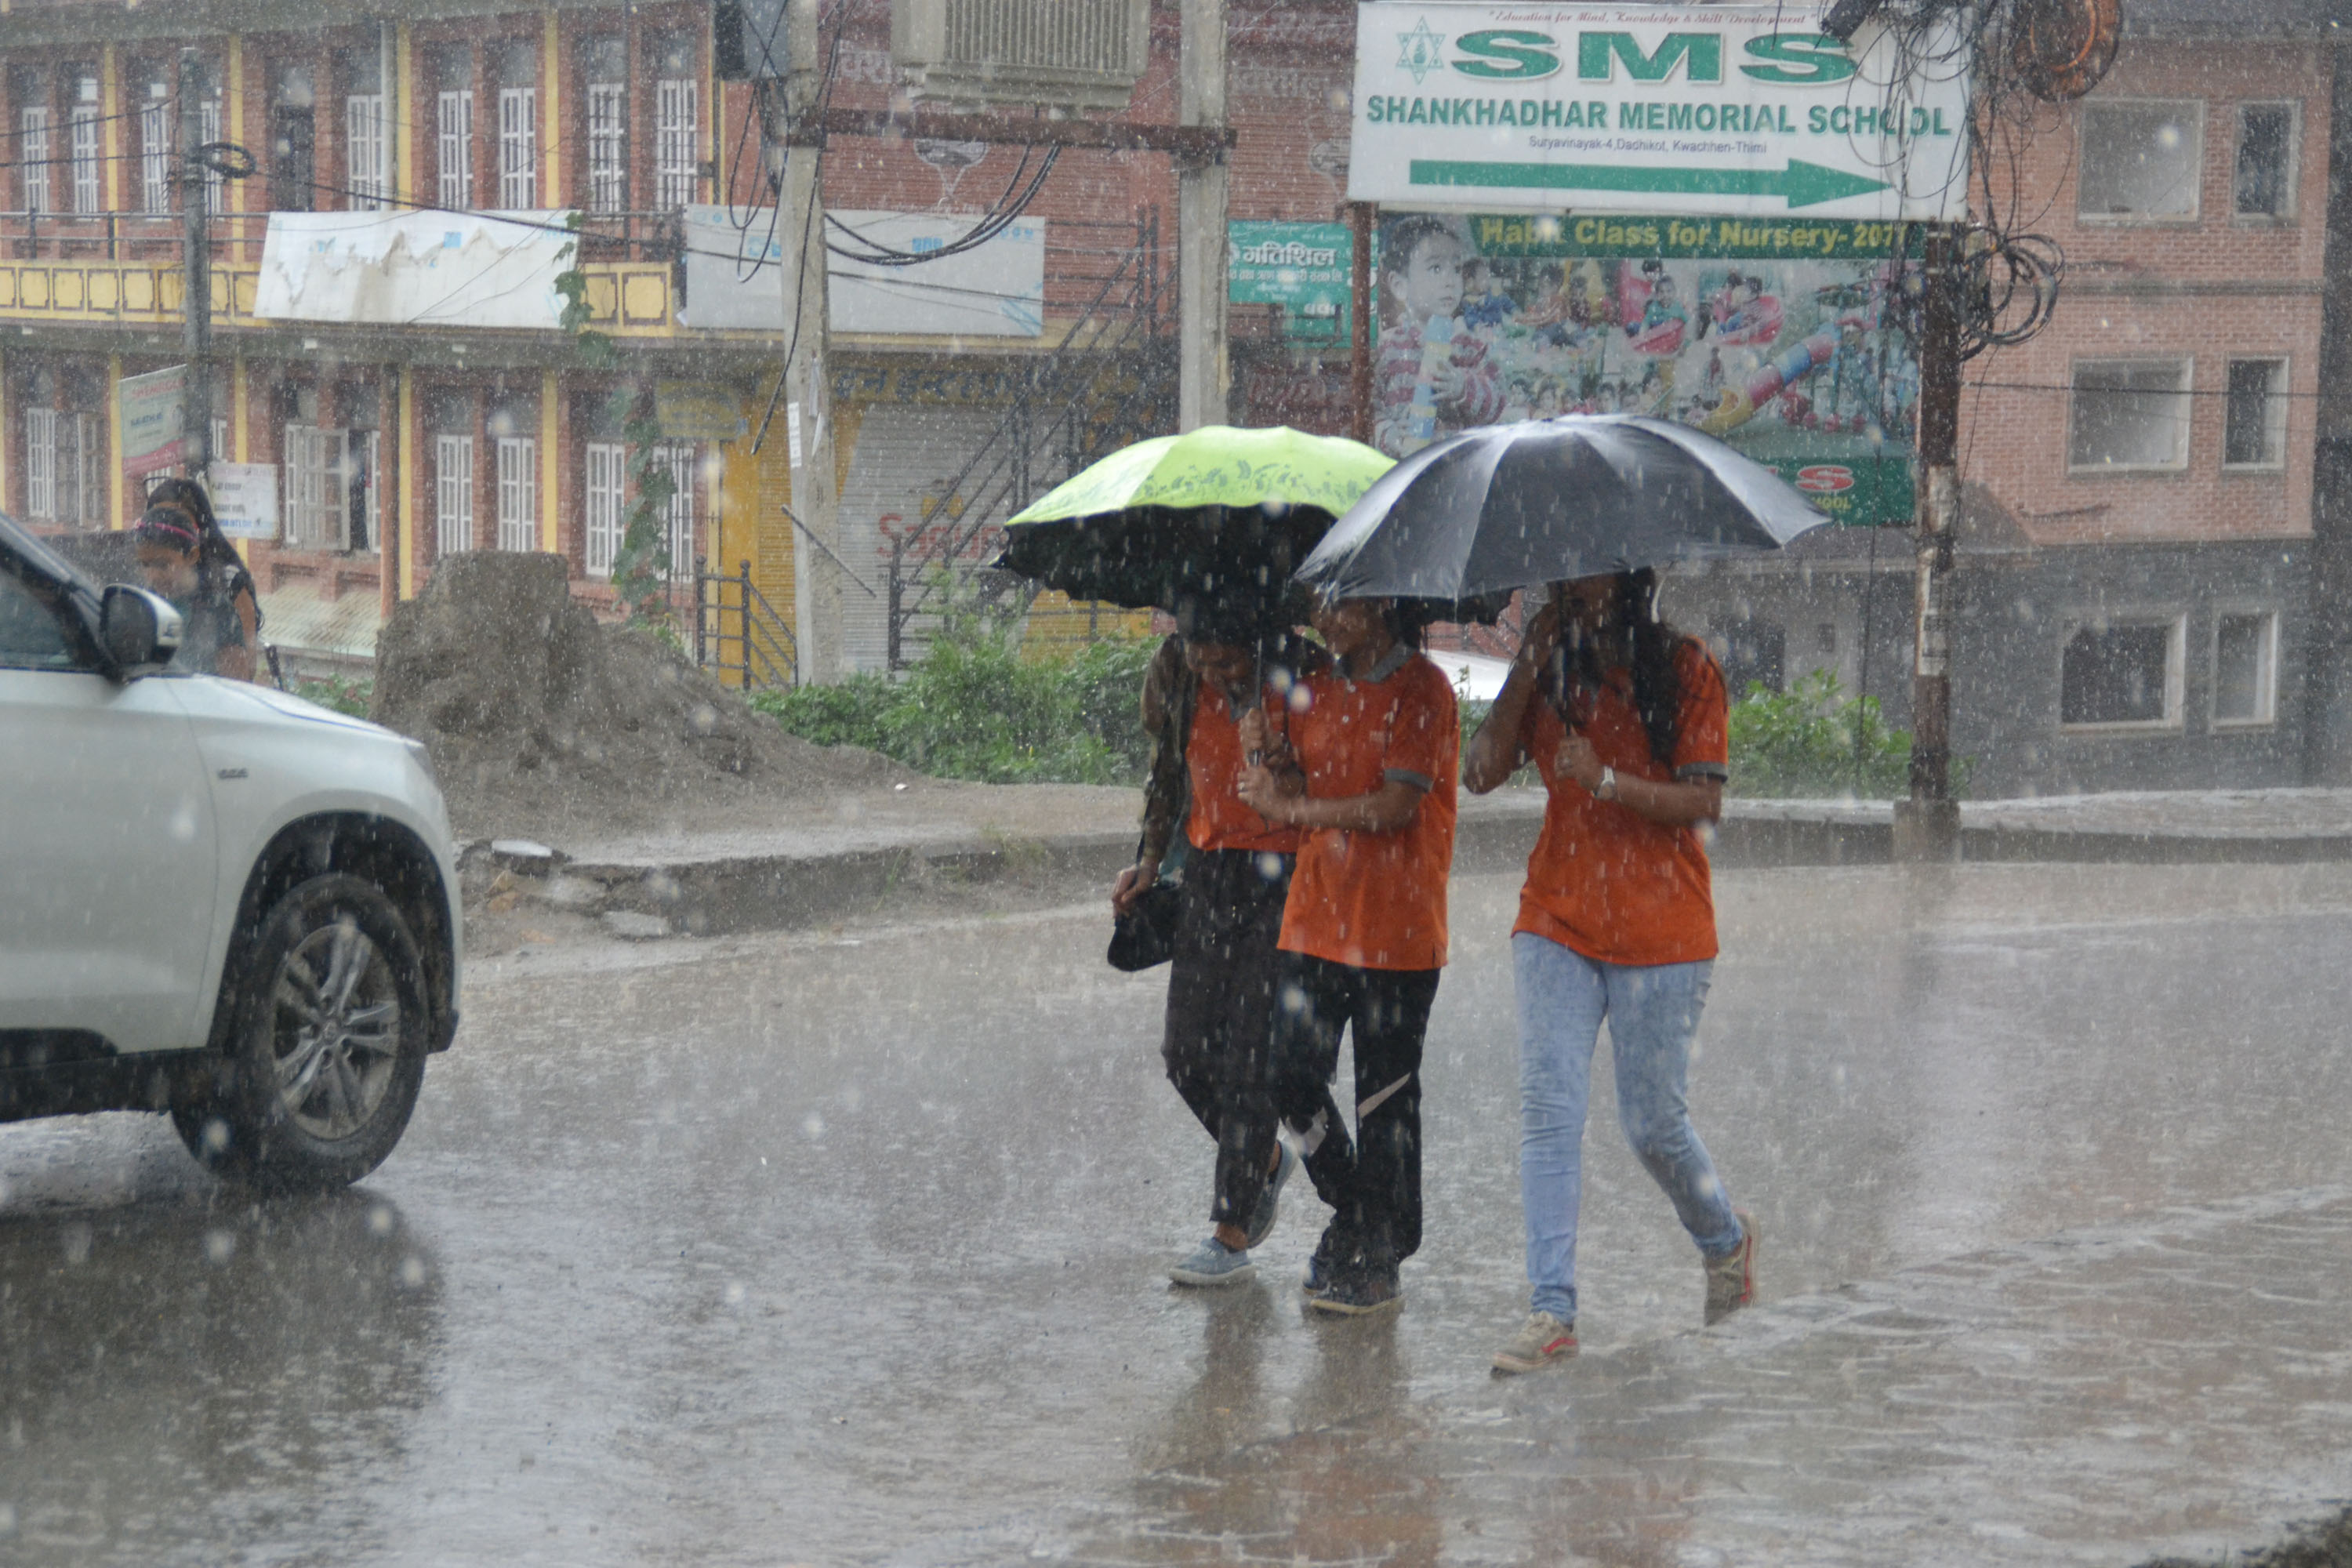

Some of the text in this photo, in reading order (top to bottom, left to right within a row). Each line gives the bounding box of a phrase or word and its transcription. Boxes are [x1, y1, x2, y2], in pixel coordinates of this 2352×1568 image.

[1450, 29, 1858, 85] SMS
[1367, 94, 1608, 130] SHANKHADHAR
[1618, 101, 1797, 133] MEMORIAL
[1481, 218, 1567, 246] Habt
[1575, 219, 1660, 247] Class
[1668, 221, 1712, 246] for
